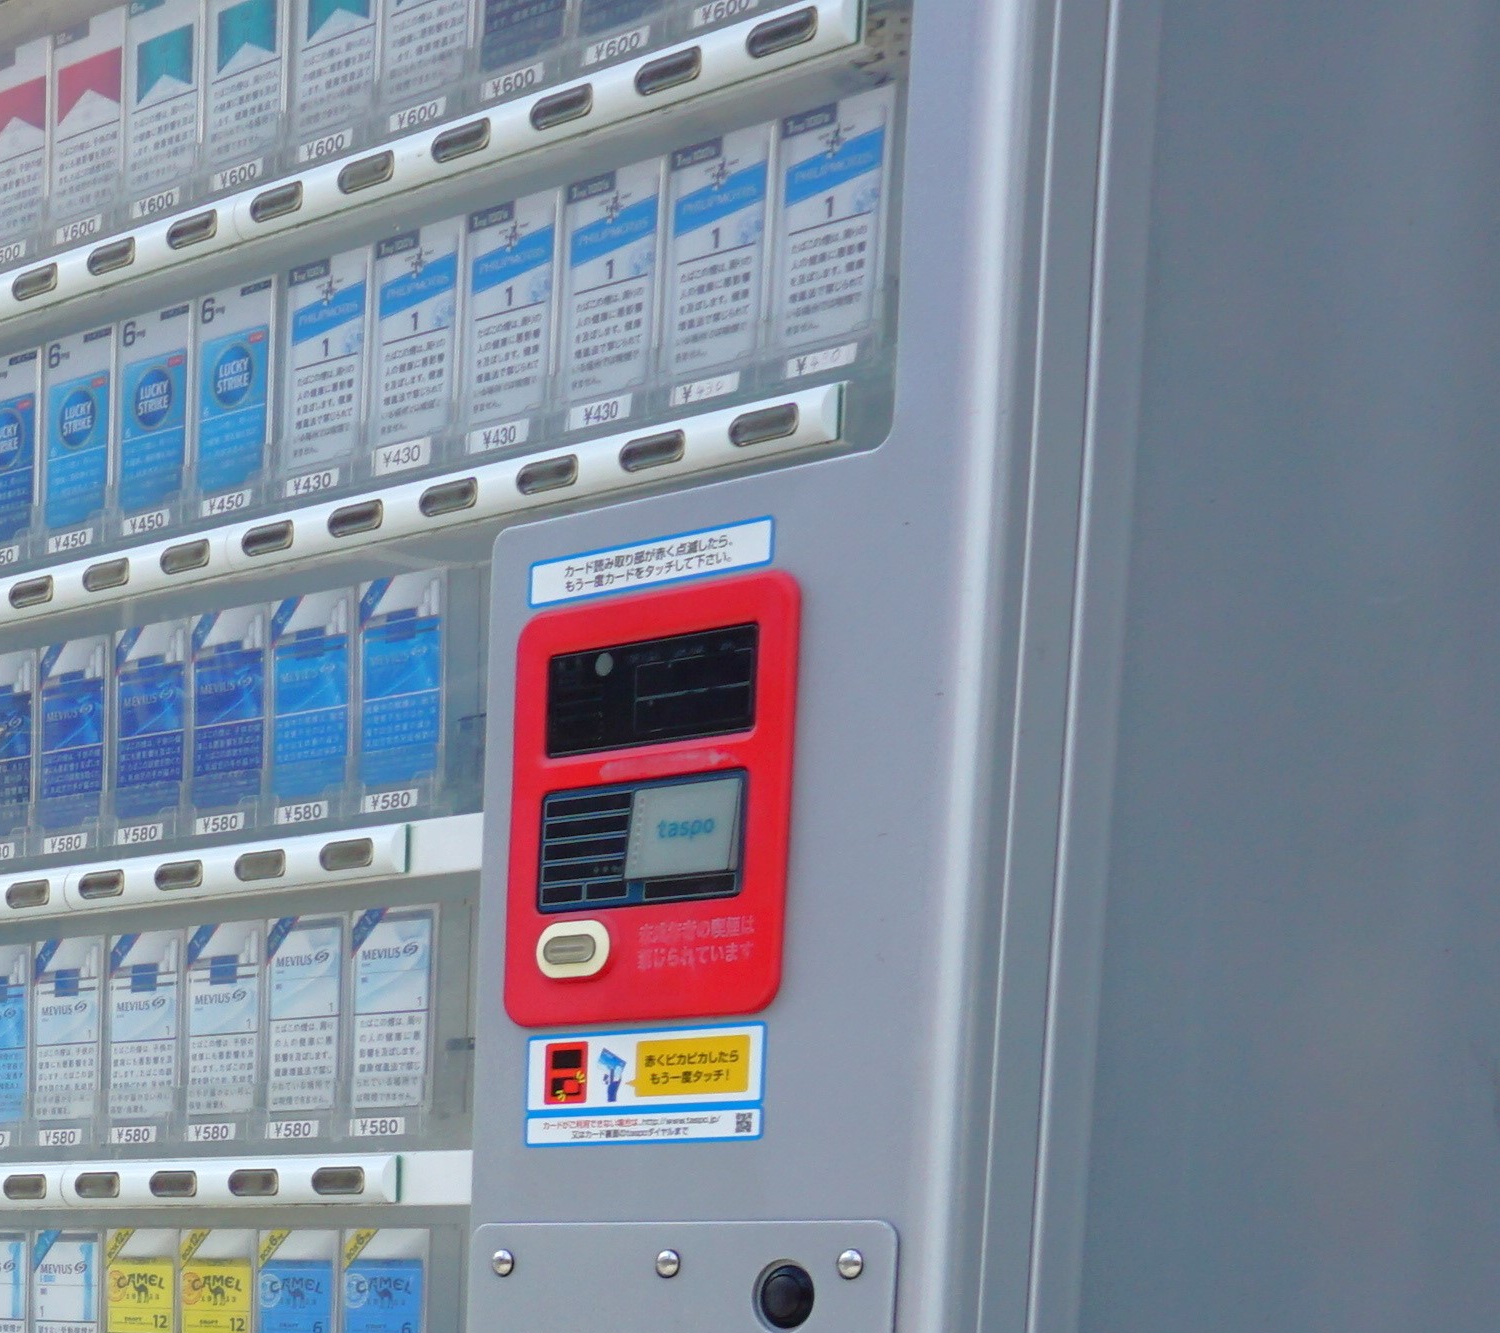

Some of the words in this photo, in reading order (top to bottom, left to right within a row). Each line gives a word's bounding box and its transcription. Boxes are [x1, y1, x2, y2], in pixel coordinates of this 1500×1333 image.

[595, 32, 641, 61] ¥600
[492, 69, 536, 96] ¥600
[397, 102, 438, 129] ¥600
[306, 133, 345, 159] ¥600
[220, 163, 257, 188] ¥600
[139, 192, 174, 216] ¥600
[62, 219, 95, 242] ¥600
[218, 357, 250, 381] LUCKY
[140, 379, 169, 401] LUCKY
[216, 371, 250, 394] STRIKE
[65, 401, 92, 423] LUCKY
[138, 393, 169, 415] STRIKE
[584, 401, 619, 421] ¥430
[62, 415, 92, 437] STRIKE
[482, 425, 517, 446] ¥430
[383, 445, 421, 467] ¥430
[293, 472, 332, 492] ¥430
[209, 493, 245, 515] ¥450
[130, 512, 164, 533] ¥450
[55, 530, 88, 550] ¥450
[370, 790, 411, 811] ¥580
[284, 803, 322, 823] ¥580
[123, 824, 158, 842] ¥580
[202, 814, 239, 833] ¥580
[656, 816, 717, 840] taspo
[49, 834, 82, 852] ¥580
[276, 953, 313, 968] MEVIUS
[362, 946, 401, 961] MEVIUS
[117, 1000, 150, 1013] MEVIUS
[195, 991, 231, 1006] MEVIUS
[42, 1003, 73, 1016] MEVIUS
[117, 1128, 150, 1143] ¥580
[194, 1125, 229, 1140] ¥580
[275, 1121, 312, 1137] ¥580
[360, 1118, 399, 1135] ¥580
[44, 1130, 77, 1145] ¥580
[40, 1263, 73, 1275] MEVIUS
[116, 1273, 165, 1291] CAMEL
[192, 1273, 243, 1293] CAMEL
[270, 1276, 323, 1295] CAMEL
[356, 1276, 412, 1296] CAMEL
